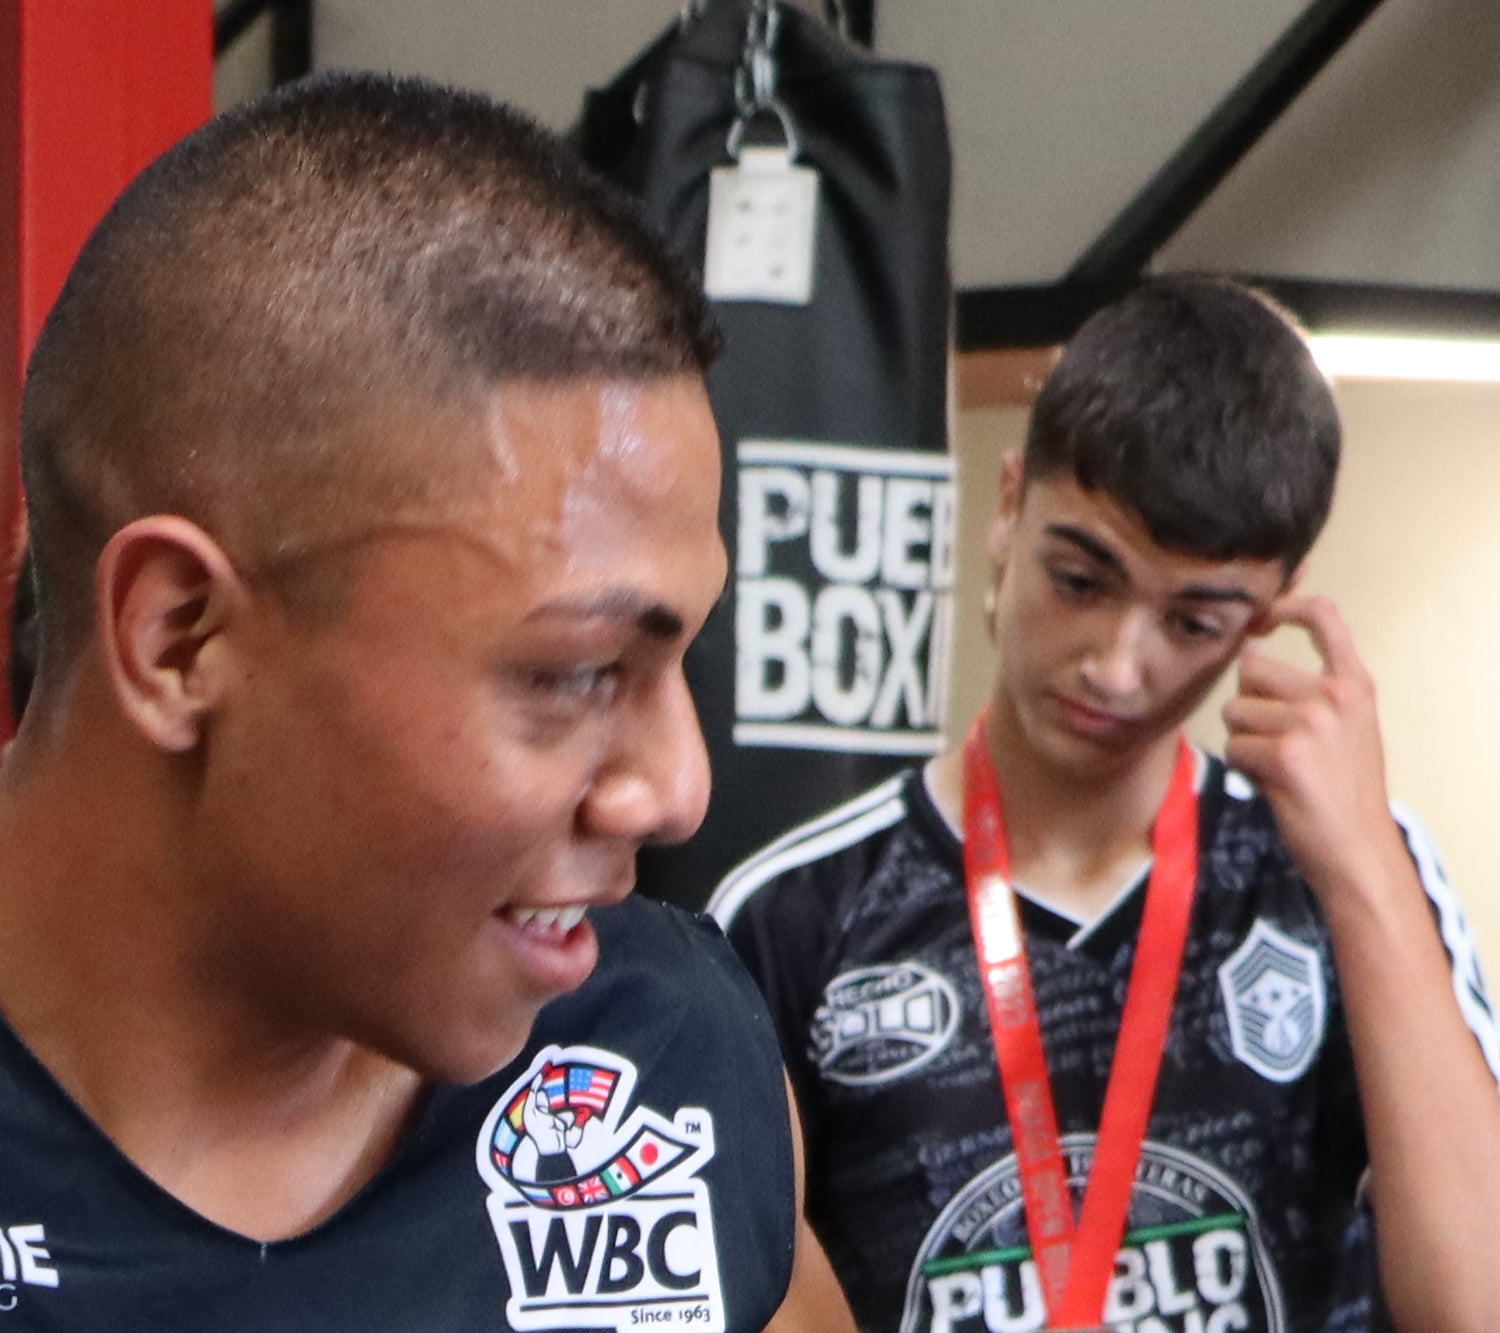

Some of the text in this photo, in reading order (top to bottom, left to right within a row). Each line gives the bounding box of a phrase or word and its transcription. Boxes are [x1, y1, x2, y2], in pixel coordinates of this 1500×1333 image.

[738, 467, 956, 588] PUE
[508, 1210, 702, 1298] WBC
[631, 1306, 711, 1324] Since 1963
